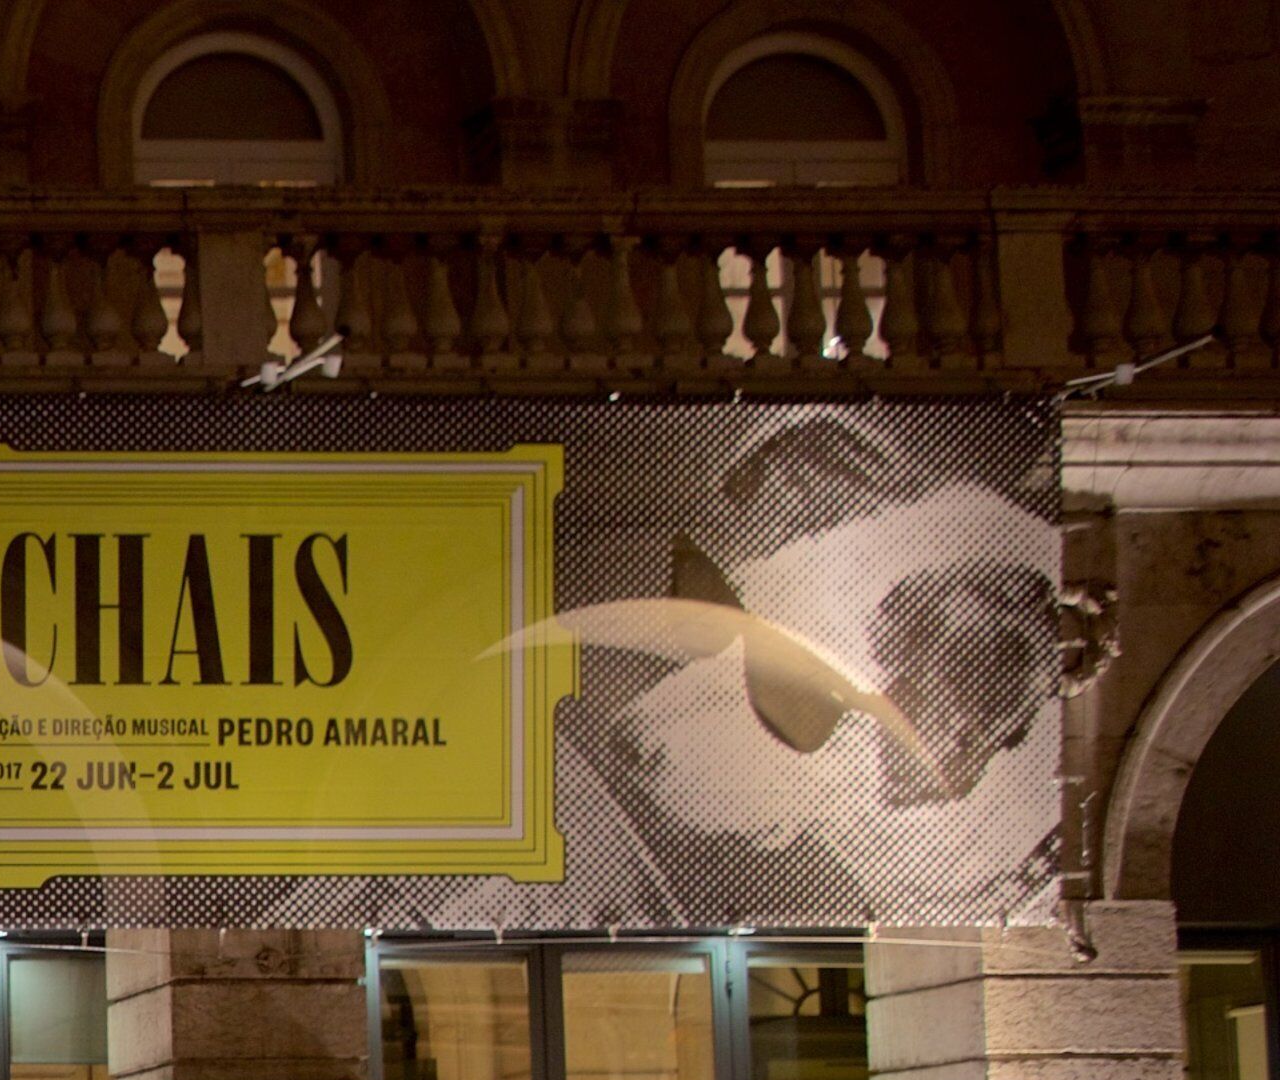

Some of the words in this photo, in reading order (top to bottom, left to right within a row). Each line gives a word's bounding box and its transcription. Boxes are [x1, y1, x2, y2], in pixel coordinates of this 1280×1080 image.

[37, 718, 48, 737] E
[52, 714, 127, 740] DIREÇÃO
[131, 717, 209, 737] MUSICAL
[217, 717, 315, 747] PEDRO
[323, 717, 448, 747] AMARAL
[30, 761, 68, 791] 22
[183, 761, 240, 790] JUL
